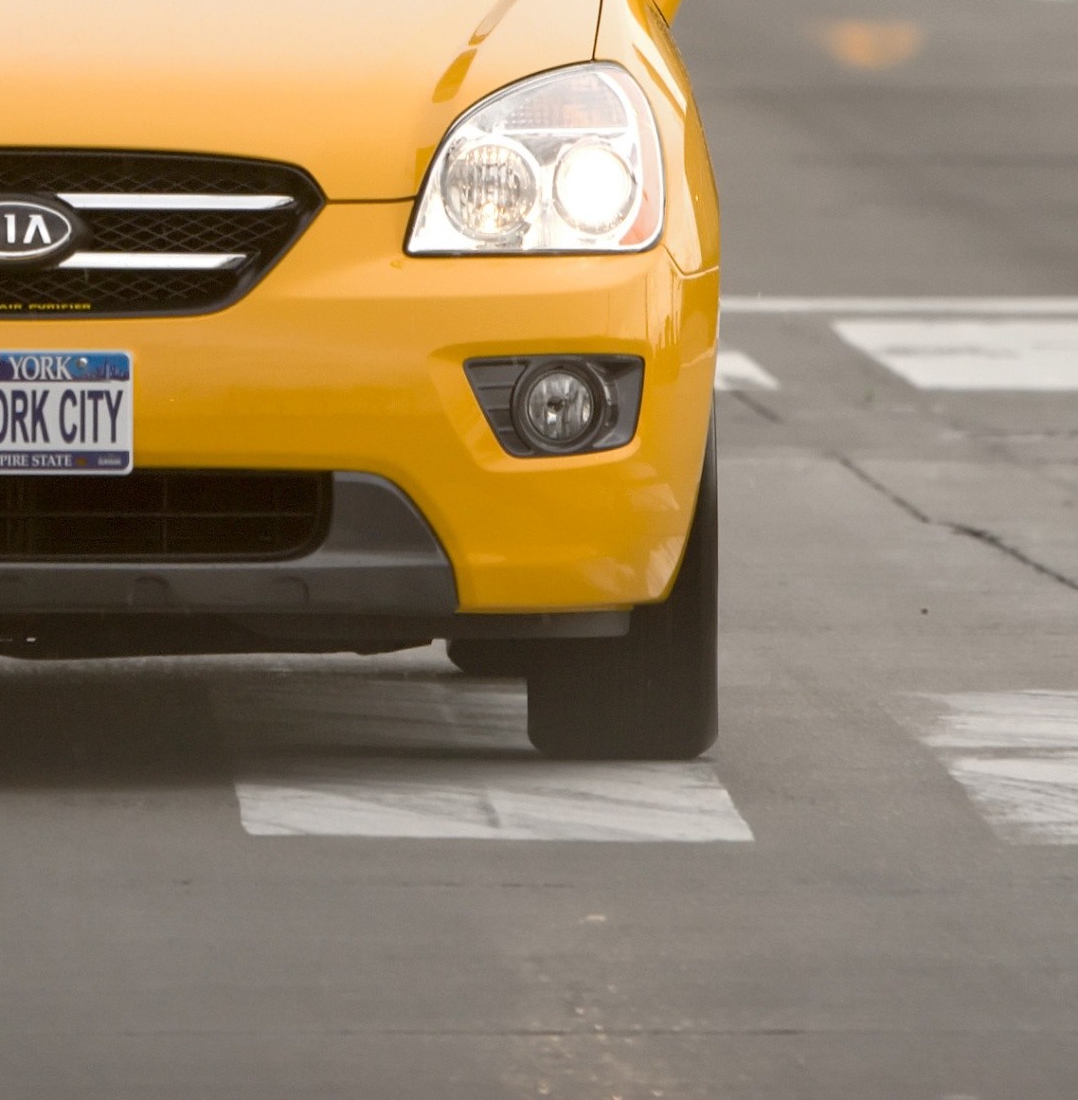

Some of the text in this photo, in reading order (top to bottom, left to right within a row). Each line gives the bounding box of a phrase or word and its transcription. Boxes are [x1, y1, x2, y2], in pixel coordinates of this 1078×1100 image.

[9, 356, 72, 381] YORK
[59, 388, 123, 444] CITY
[32, 454, 72, 467] STATE
